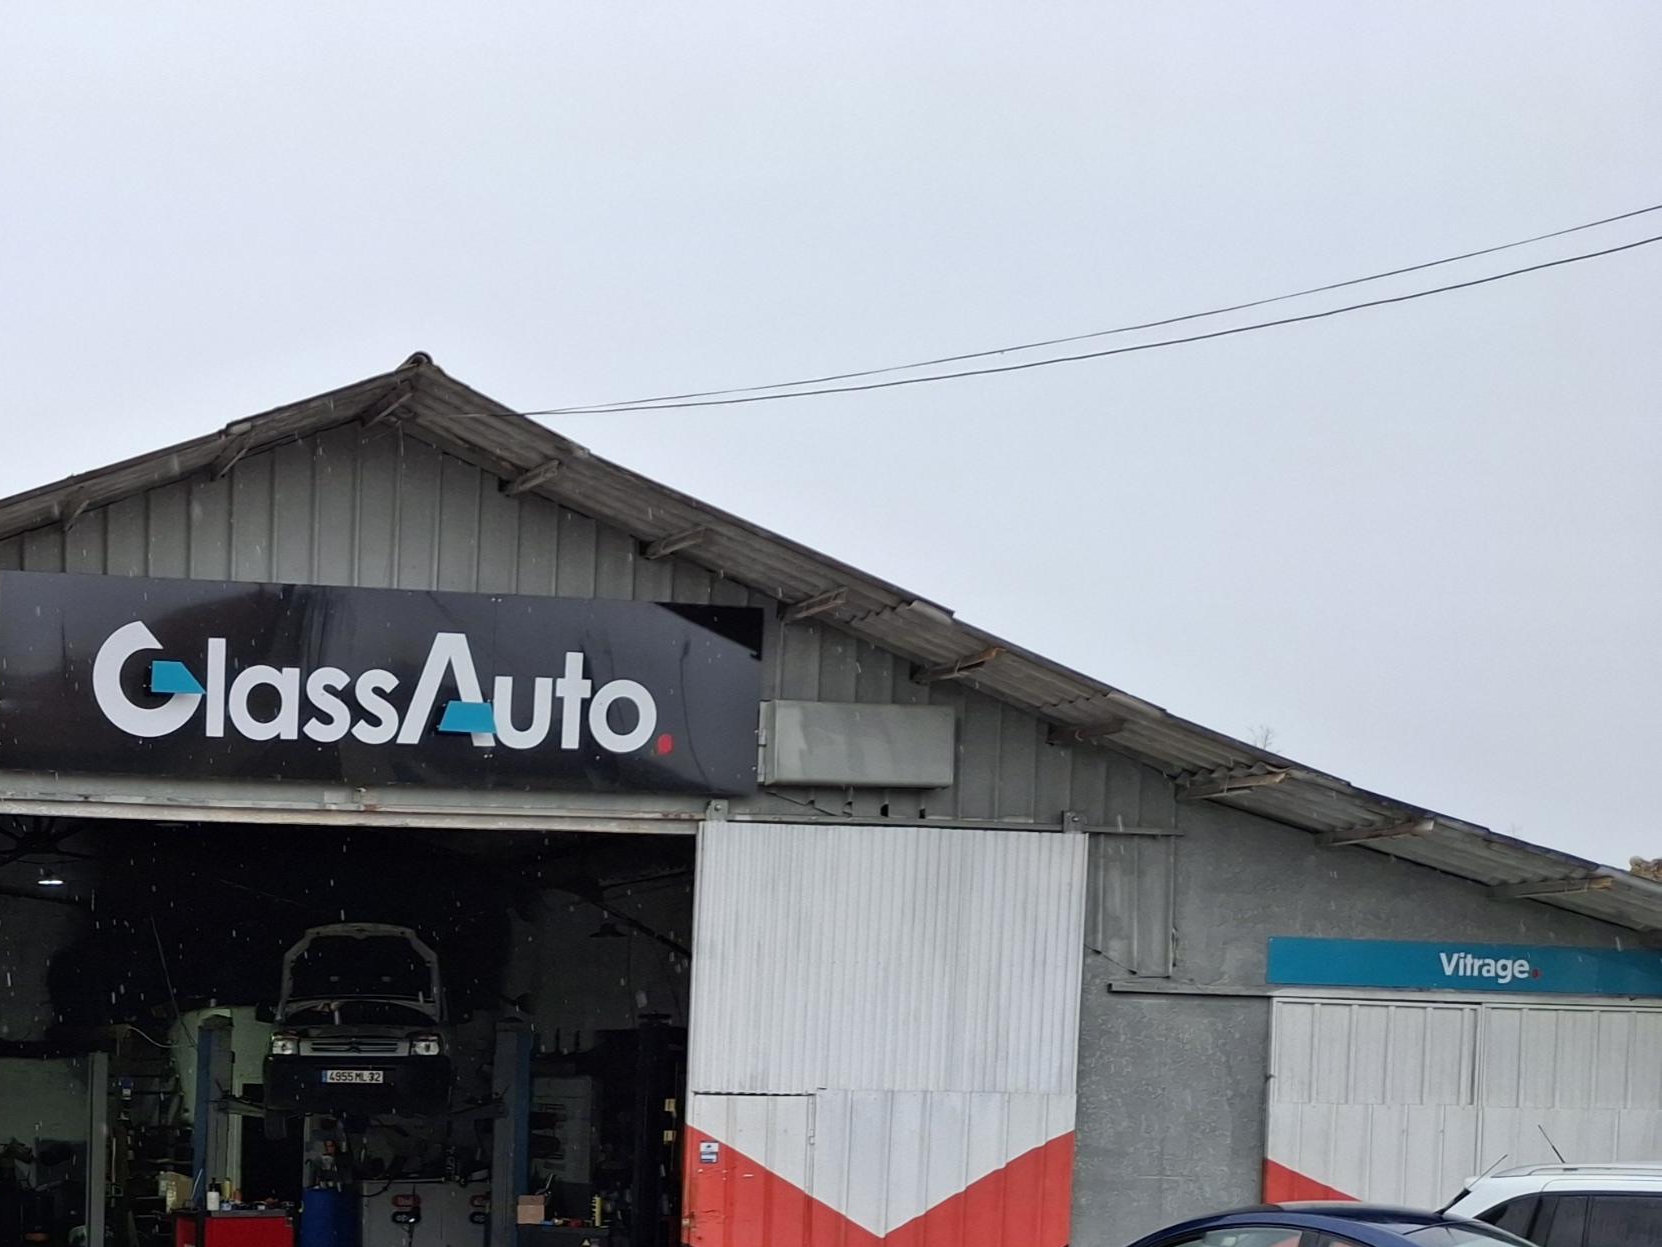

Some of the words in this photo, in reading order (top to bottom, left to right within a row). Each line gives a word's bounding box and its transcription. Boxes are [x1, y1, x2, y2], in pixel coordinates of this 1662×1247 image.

[1439, 952, 1542, 984] Vitrage.
[329, 1071, 353, 1082] 4955
[355, 1072, 367, 1082] ML
[368, 1072, 381, 1082] 32
